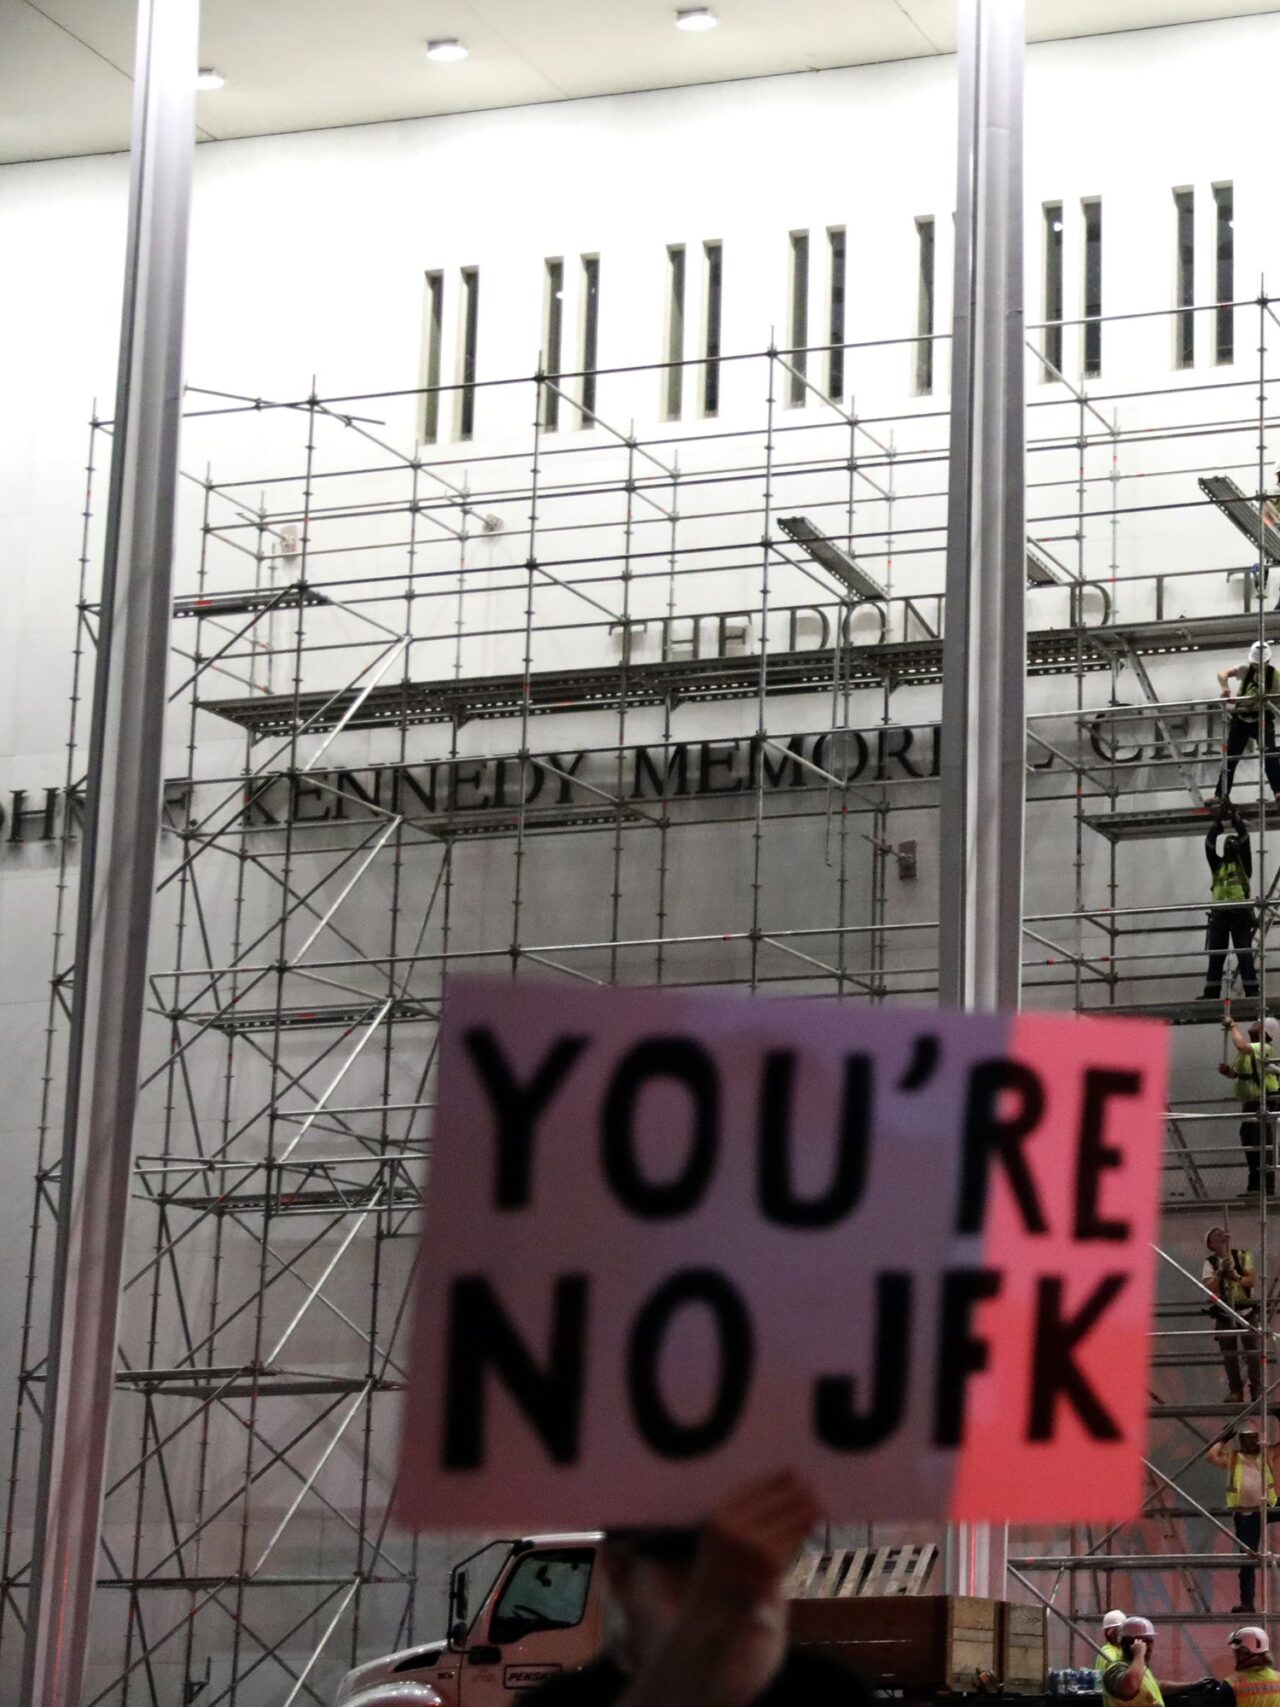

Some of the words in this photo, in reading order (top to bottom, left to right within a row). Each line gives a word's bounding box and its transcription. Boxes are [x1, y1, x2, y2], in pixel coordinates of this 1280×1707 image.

[608, 611, 753, 665] THE
[789, 574, 1113, 652] DOND
[236, 751, 588, 826] KENNEDY
[631, 722, 1055, 799] MEMORI
[461, 1027, 1146, 1243] YOU'RE
[440, 1266, 754, 1471] NO
[813, 1268, 1129, 1451] JFK
